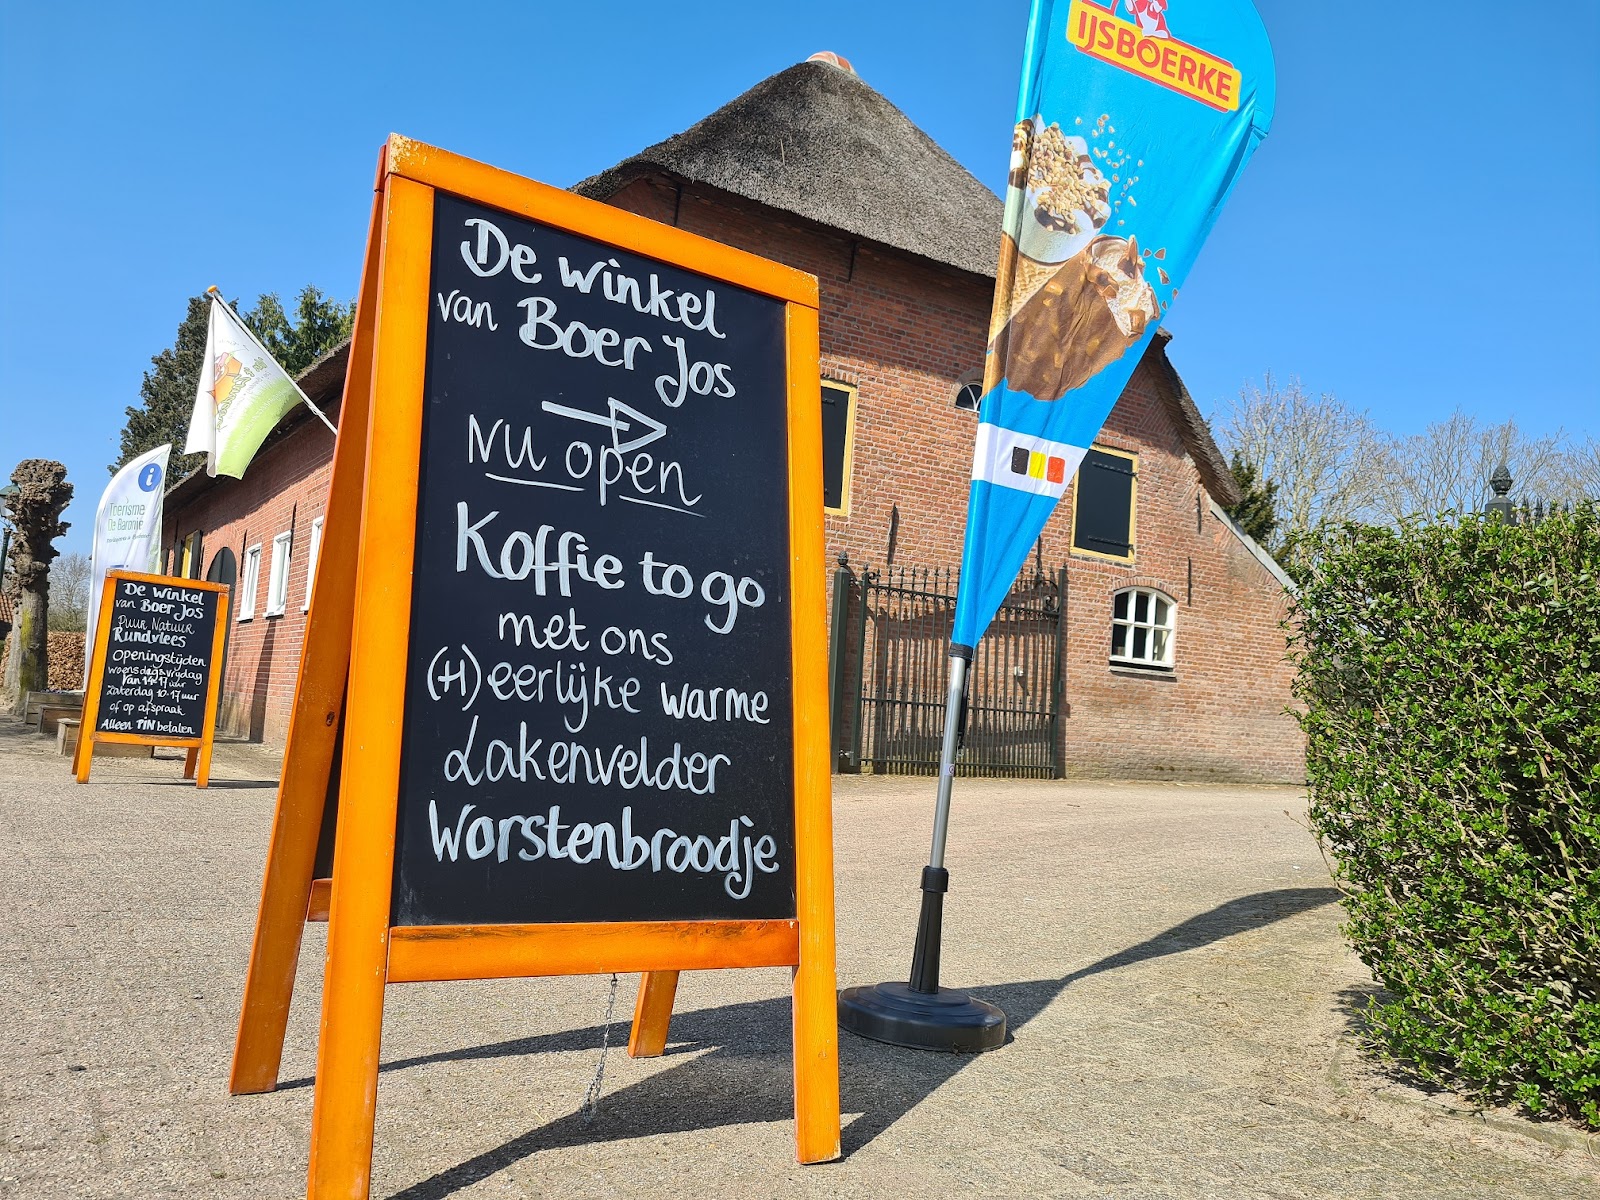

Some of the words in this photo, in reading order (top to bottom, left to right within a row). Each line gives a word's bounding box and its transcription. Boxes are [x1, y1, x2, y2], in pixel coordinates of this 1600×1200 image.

[1078, 10, 1232, 102] IJSBOERKE
[460, 218, 542, 284] De
[438, 290, 499, 332] van
[517, 296, 653, 370] Boer
[655, 335, 736, 408] Jos
[565, 440, 702, 507] open
[108, 518, 116, 531] De
[456, 501, 625, 597] Koffie
[638, 551, 694, 598] to
[701, 571, 766, 635] go
[115, 598, 137, 609] van
[140, 598, 176, 615] Boer
[173, 603, 204, 622] Jos
[123, 582, 146, 597] De
[112, 626, 187, 648] Rundvlees
[499, 608, 590, 652] met
[600, 626, 673, 666] ons
[168, 680, 187, 688] uur
[181, 693, 200, 701] uur
[100, 718, 133, 731] Alleen
[157, 720, 196, 735] betalen
[109, 700, 122, 713] of
[123, 703, 135, 716] op
[138, 700, 186, 716] afspraak
[443, 715, 732, 795] Lakenvelder
[428, 799, 780, 900] Worstenbroodje
